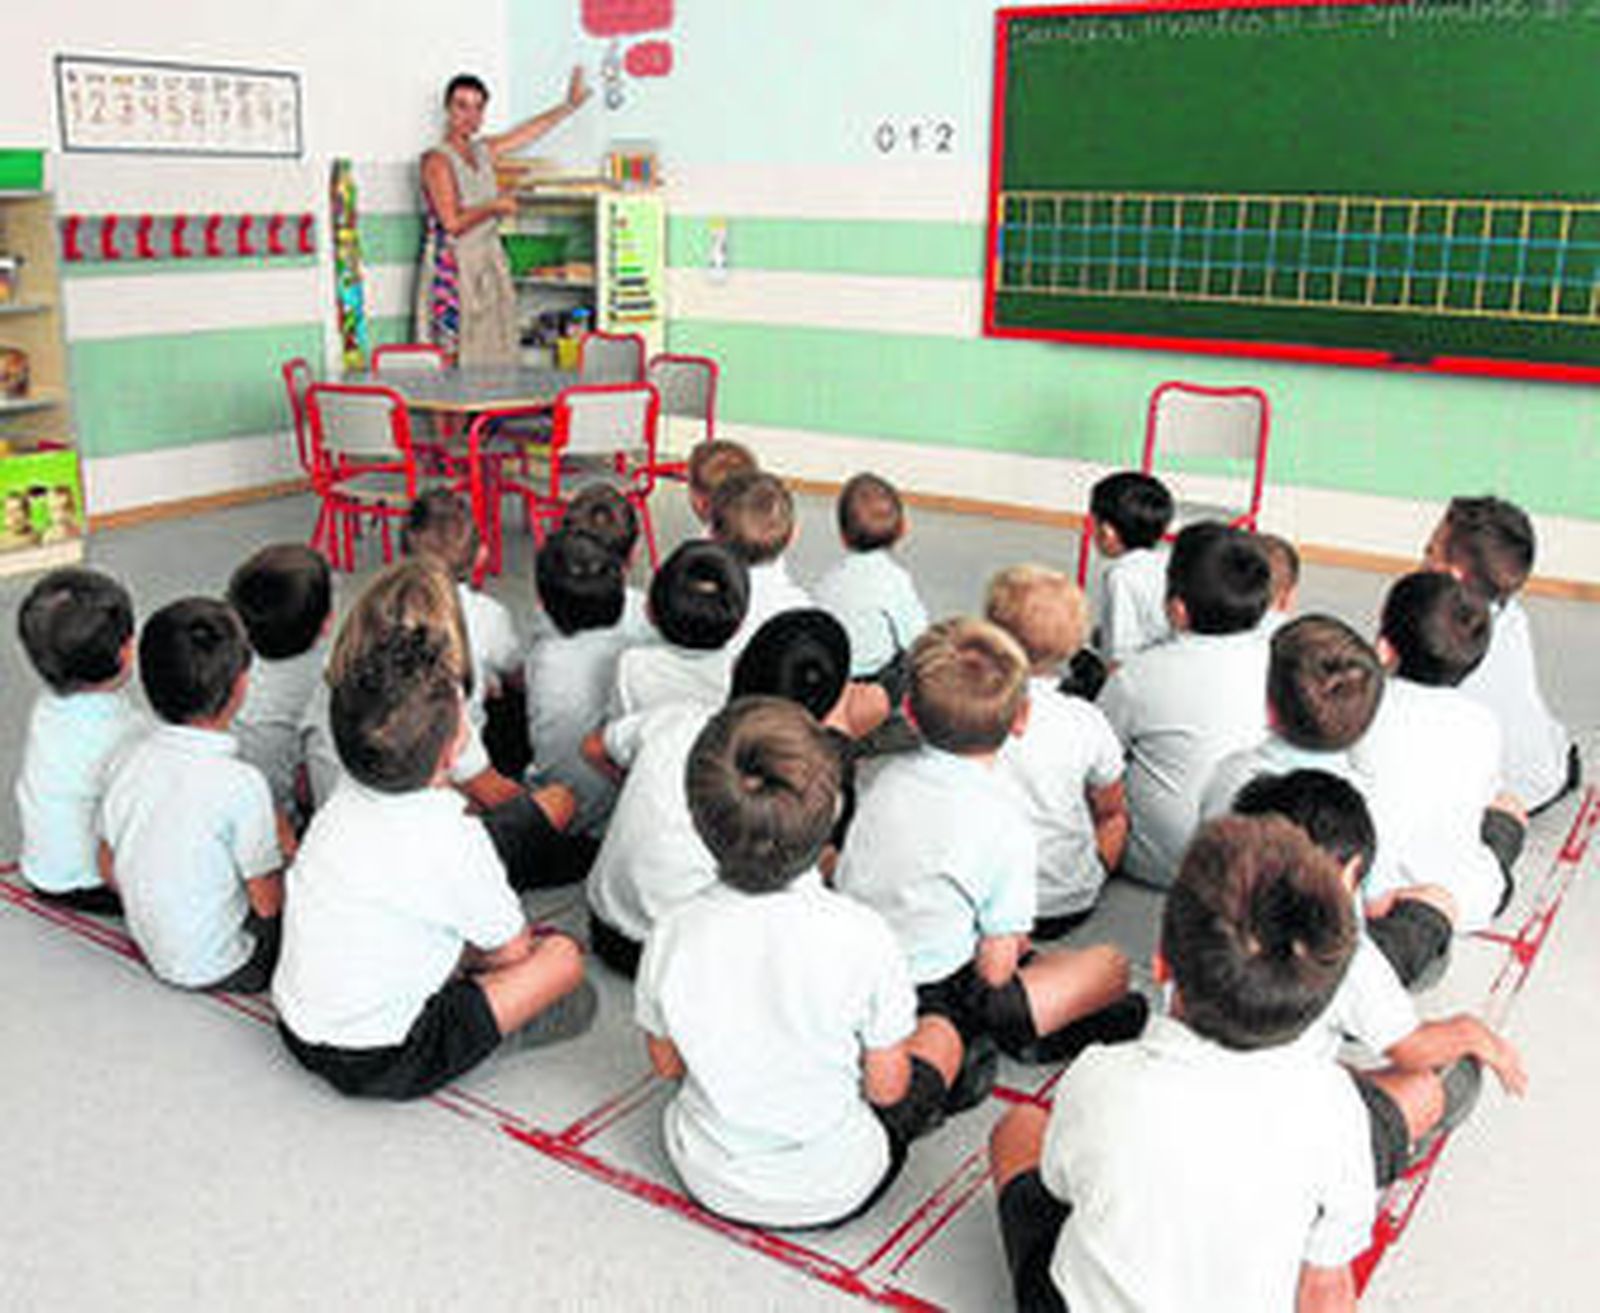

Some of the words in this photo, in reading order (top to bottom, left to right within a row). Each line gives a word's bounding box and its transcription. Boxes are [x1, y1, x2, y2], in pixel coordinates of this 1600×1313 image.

[89, 91, 106, 124] 2
[116, 92, 134, 126] 3
[140, 95, 160, 122] 4
[166, 96, 185, 127] 5
[873, 121, 897, 154] 0
[909, 123, 921, 153] 1
[934, 122, 955, 154] 2
